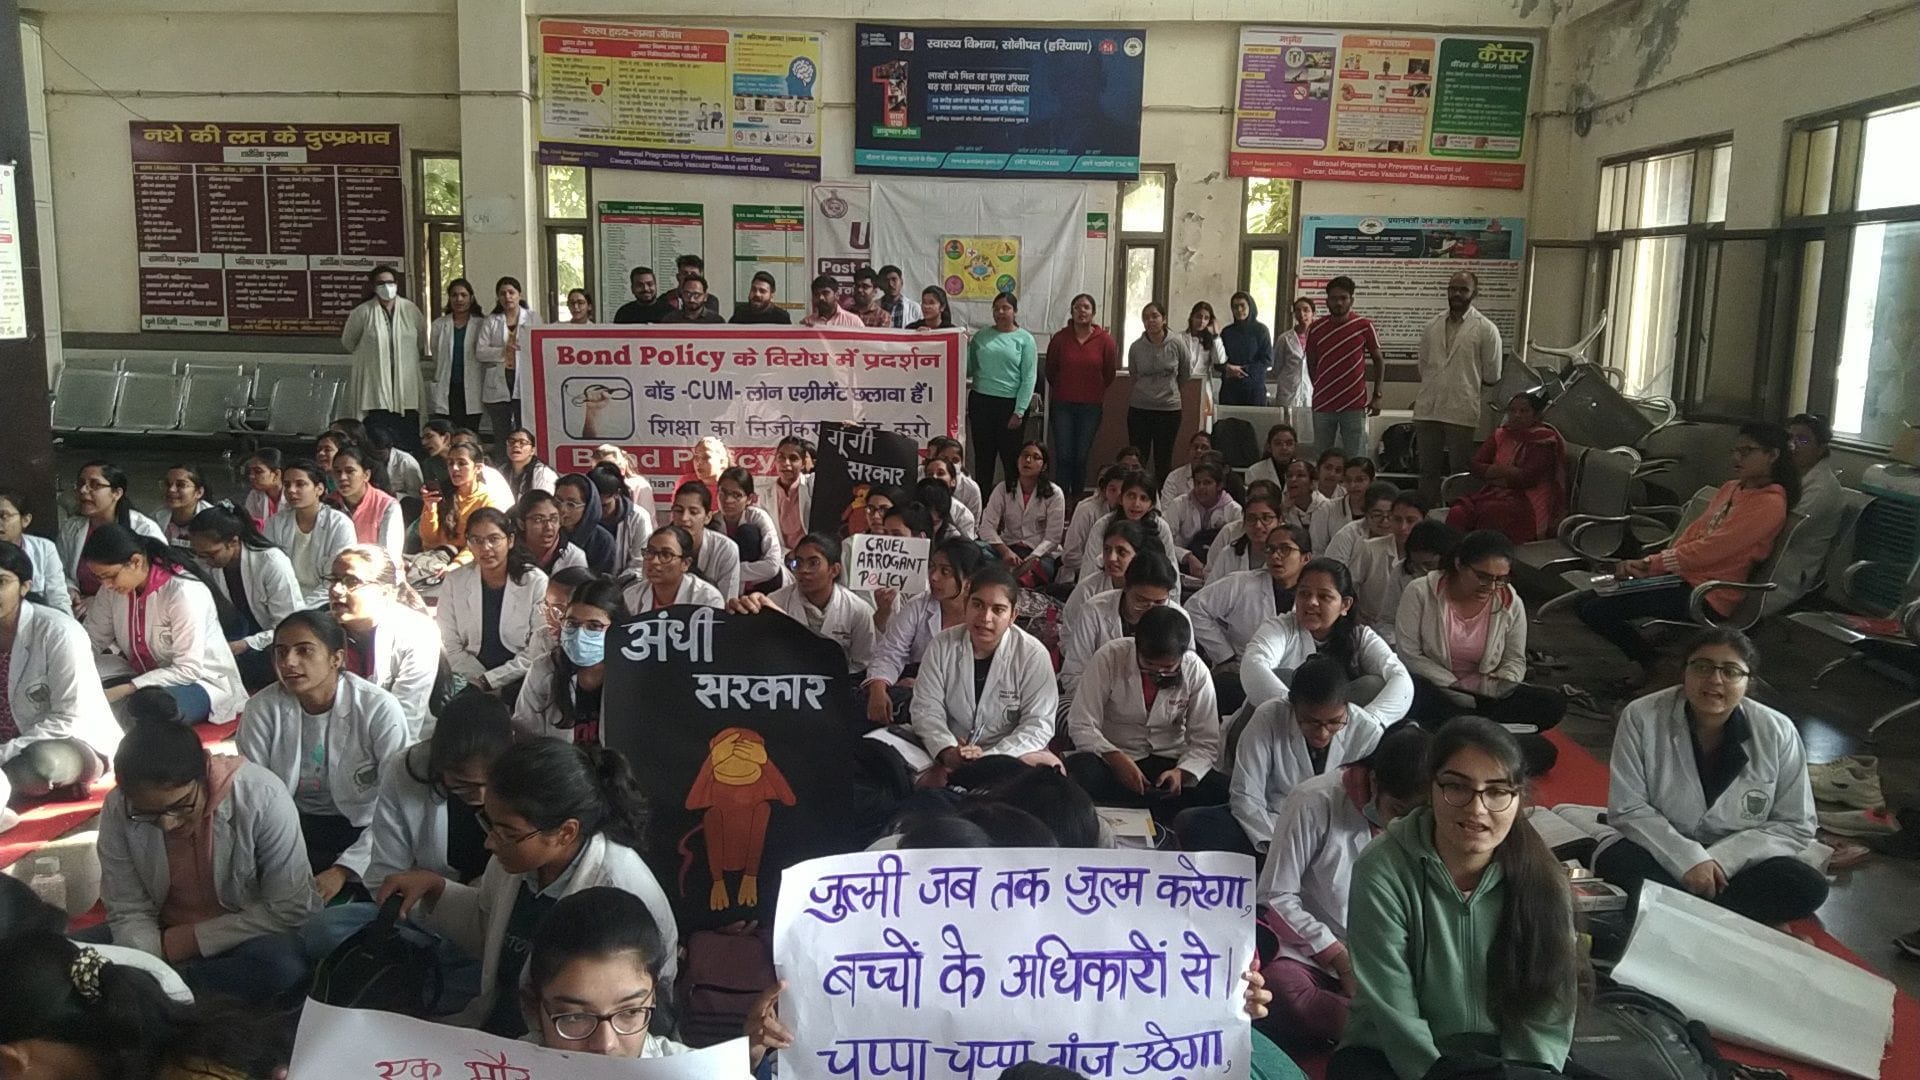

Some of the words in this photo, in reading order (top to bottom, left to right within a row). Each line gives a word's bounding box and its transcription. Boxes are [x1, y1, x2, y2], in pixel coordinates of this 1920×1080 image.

[926, 39, 962, 49] स्वास्थ्य
[964, 36, 999, 50] विभाग,
[1002, 38, 1041, 50] सोनीपत
[1044, 38, 1092, 54] (हरियाणा)
[1478, 43, 1530, 63] कैंसर
[948, 70, 960, 80] को
[977, 73, 989, 81] रहा
[1007, 74, 1030, 82] उपचार
[940, 83, 952, 92] रहा
[954, 83, 985, 94] आयुष्मान
[1006, 82, 1031, 93] परिवार
[143, 124, 184, 143] नशे
[189, 124, 221, 144] की
[226, 131, 268, 145] लत
[272, 125, 298, 144] के
[303, 130, 392, 151] दुष्प्रभाव
[610, 157, 633, 165] Cancer,
[663, 160, 684, 168] Cardio
[685, 161, 710, 169] Vascular
[619, 150, 643, 158] National
[645, 151, 680, 160] Programme
[691, 153, 723, 161] Prevention
[1340, 161, 1377, 169] Programme
[1389, 162, 1423, 171] Prevention
[1303, 168, 1326, 176] Cancer,
[822, 261, 856, 274] Post
[557, 346, 632, 366] Bond
[641, 345, 725, 372] Policy
[733, 348, 759, 367] के
[766, 347, 828, 367] विरोध
[836, 347, 860, 367] में
[863, 346, 942, 372] प्रदर्शन
[746, 382, 783, 402] लोन
[788, 381, 848, 404] एग्रीमेंट
[851, 385, 906, 403] छलावा
[648, 414, 700, 440] शिक्षा
[711, 420, 735, 437] का
[745, 414, 821, 438] निजीकर
[827, 427, 877, 458] गूंगी
[848, 462, 906, 485] सरकार
[865, 536, 909, 554] CRUEL
[856, 551, 928, 574] ARROGANT
[858, 571, 909, 591] POLICY
[619, 605, 725, 663] अंधी
[693, 673, 834, 710] सरकार
[803, 853, 909, 924] जुल्मी
[918, 865, 981, 909] जब
[991, 867, 1050, 911] तक
[1064, 865, 1151, 916] जुल्म
[822, 926, 925, 1009] बच्चों
[938, 922, 986, 1008] के
[1000, 928, 1168, 1003] अधिकारों
